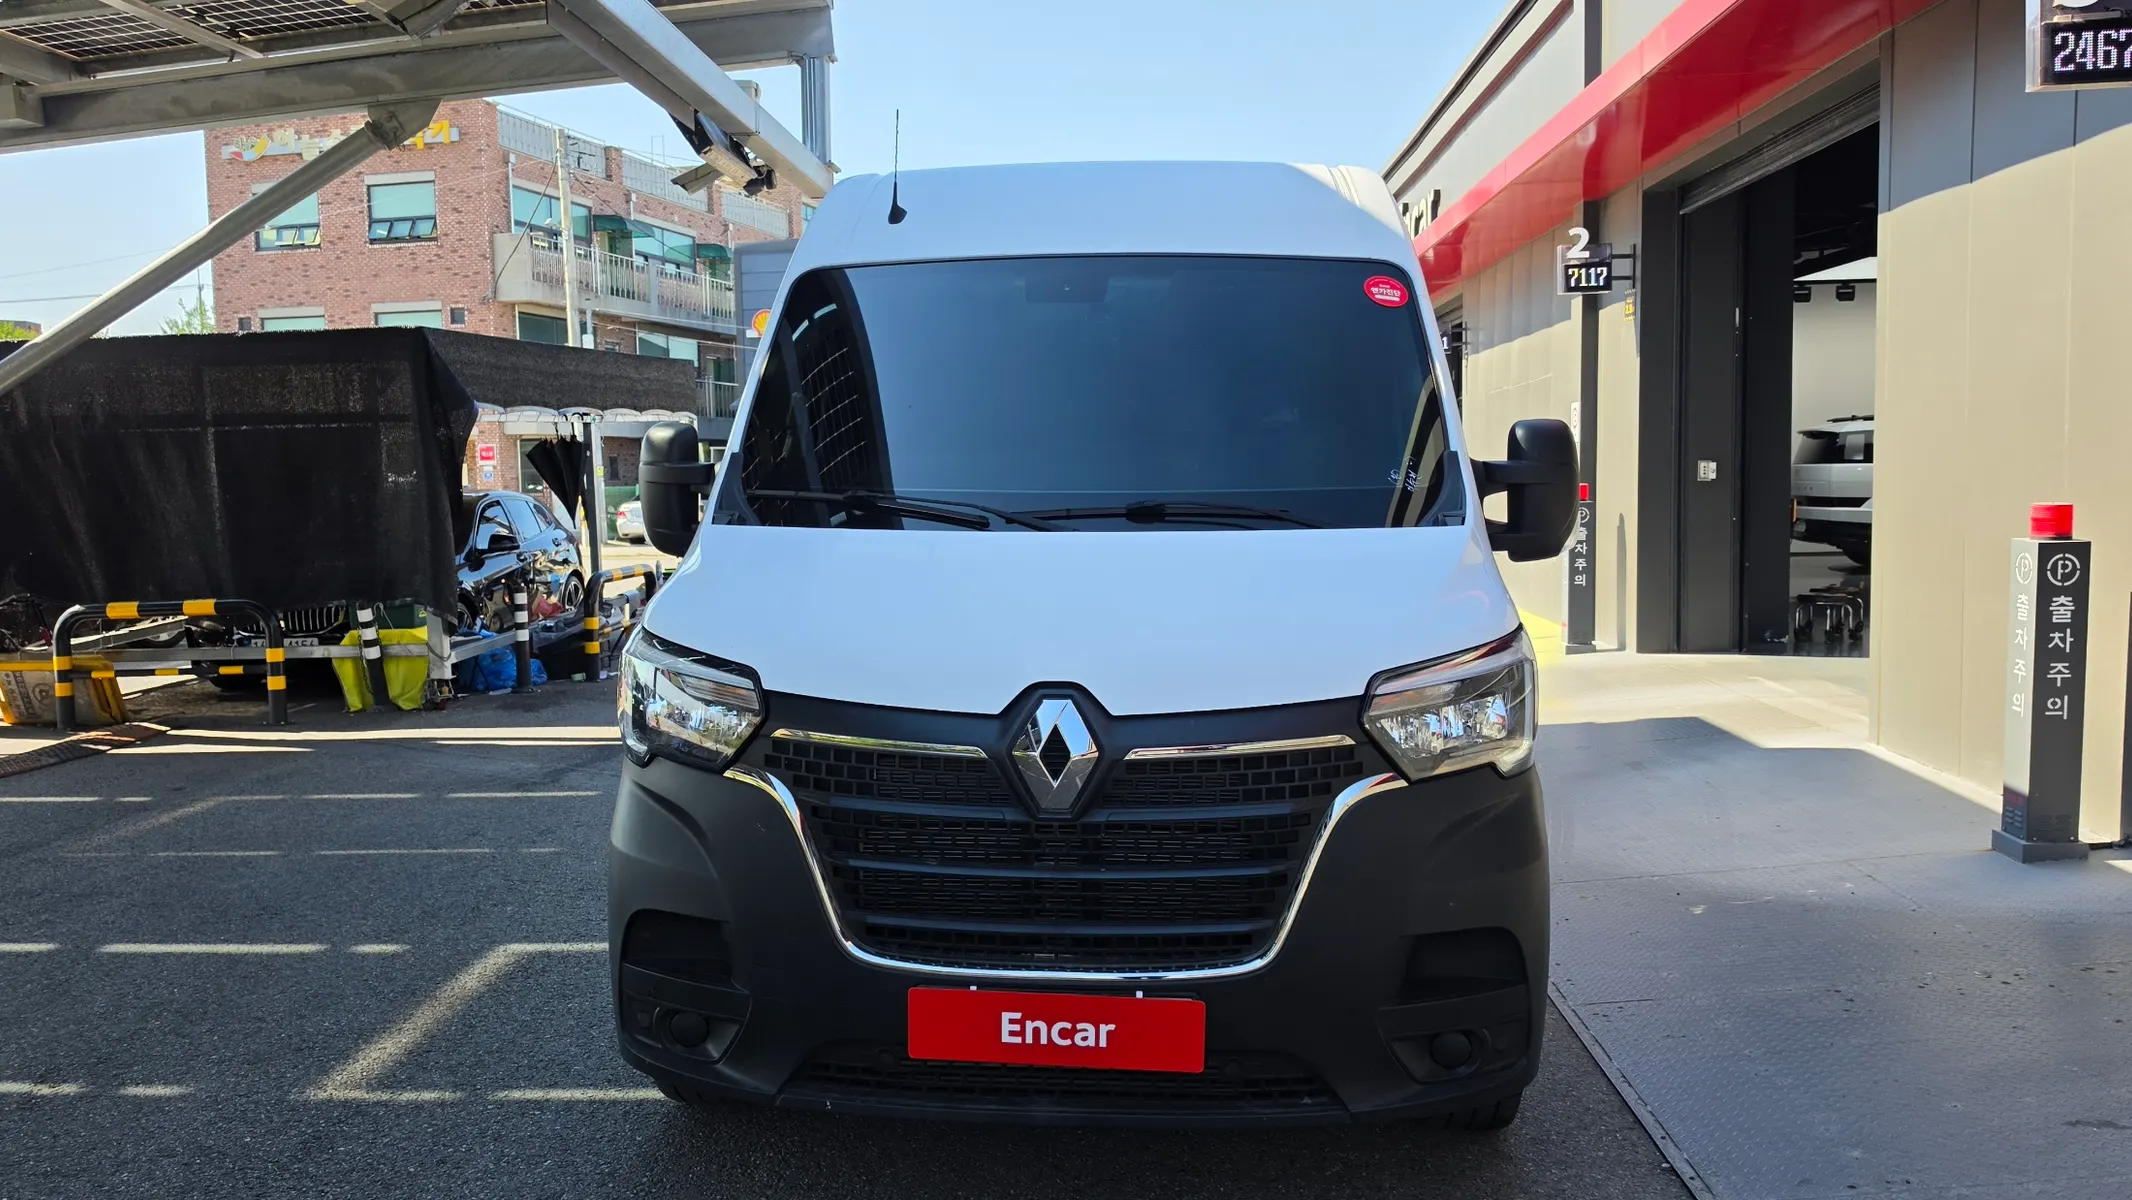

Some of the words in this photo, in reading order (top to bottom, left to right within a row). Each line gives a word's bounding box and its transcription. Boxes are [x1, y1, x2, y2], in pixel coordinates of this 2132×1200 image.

[1566, 227, 1590, 259] 2
[1568, 266, 1608, 287] 7117
[2012, 593, 2029, 718] 출차주의
[2045, 595, 2076, 720] 출차주의
[1001, 1011, 1116, 1048] Encar
